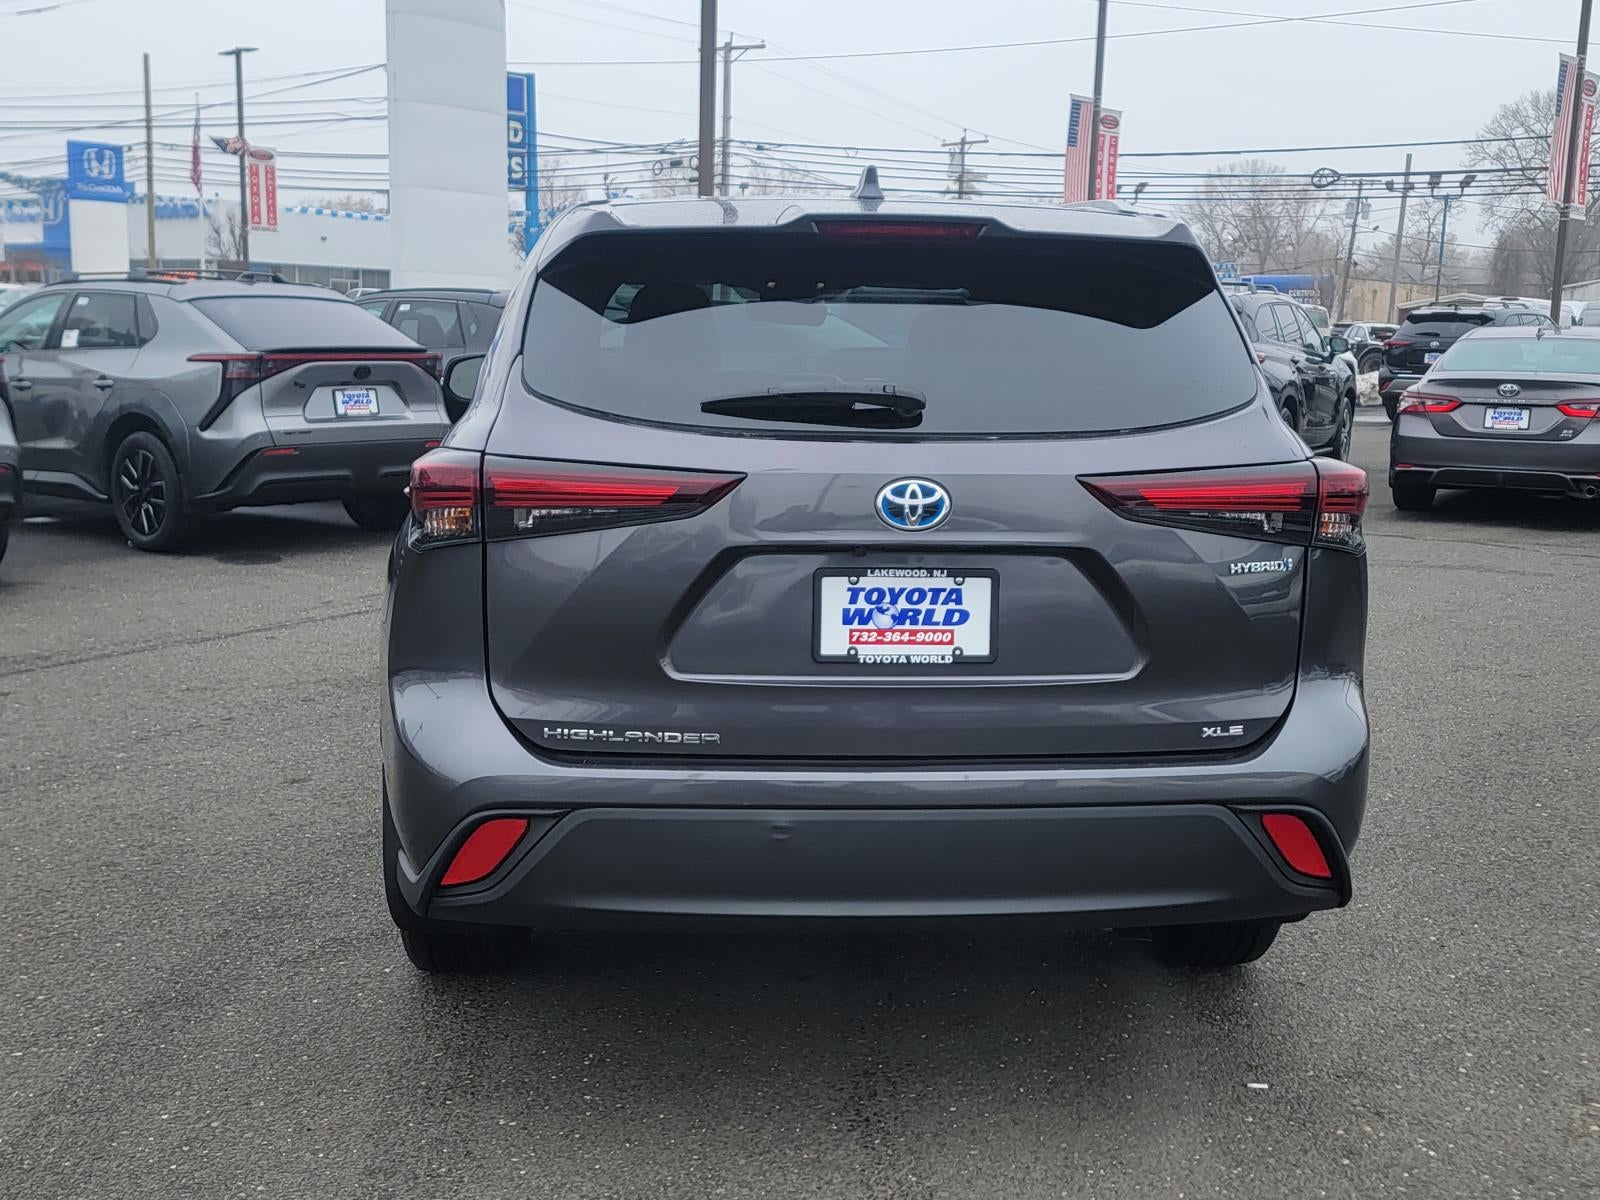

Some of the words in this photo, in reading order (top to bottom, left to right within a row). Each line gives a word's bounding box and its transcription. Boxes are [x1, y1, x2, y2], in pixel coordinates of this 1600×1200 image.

[933, 569, 947, 578] NJ
[1230, 560, 1285, 574] HYBRID
[846, 587, 963, 606] TOYOTA
[851, 631, 951, 643] 732-364-9000
[858, 655, 907, 664] TOYOTA
[910, 655, 953, 664] WORLD
[543, 727, 721, 745] HIGHLANDER
[1201, 725, 1244, 738] XLE
